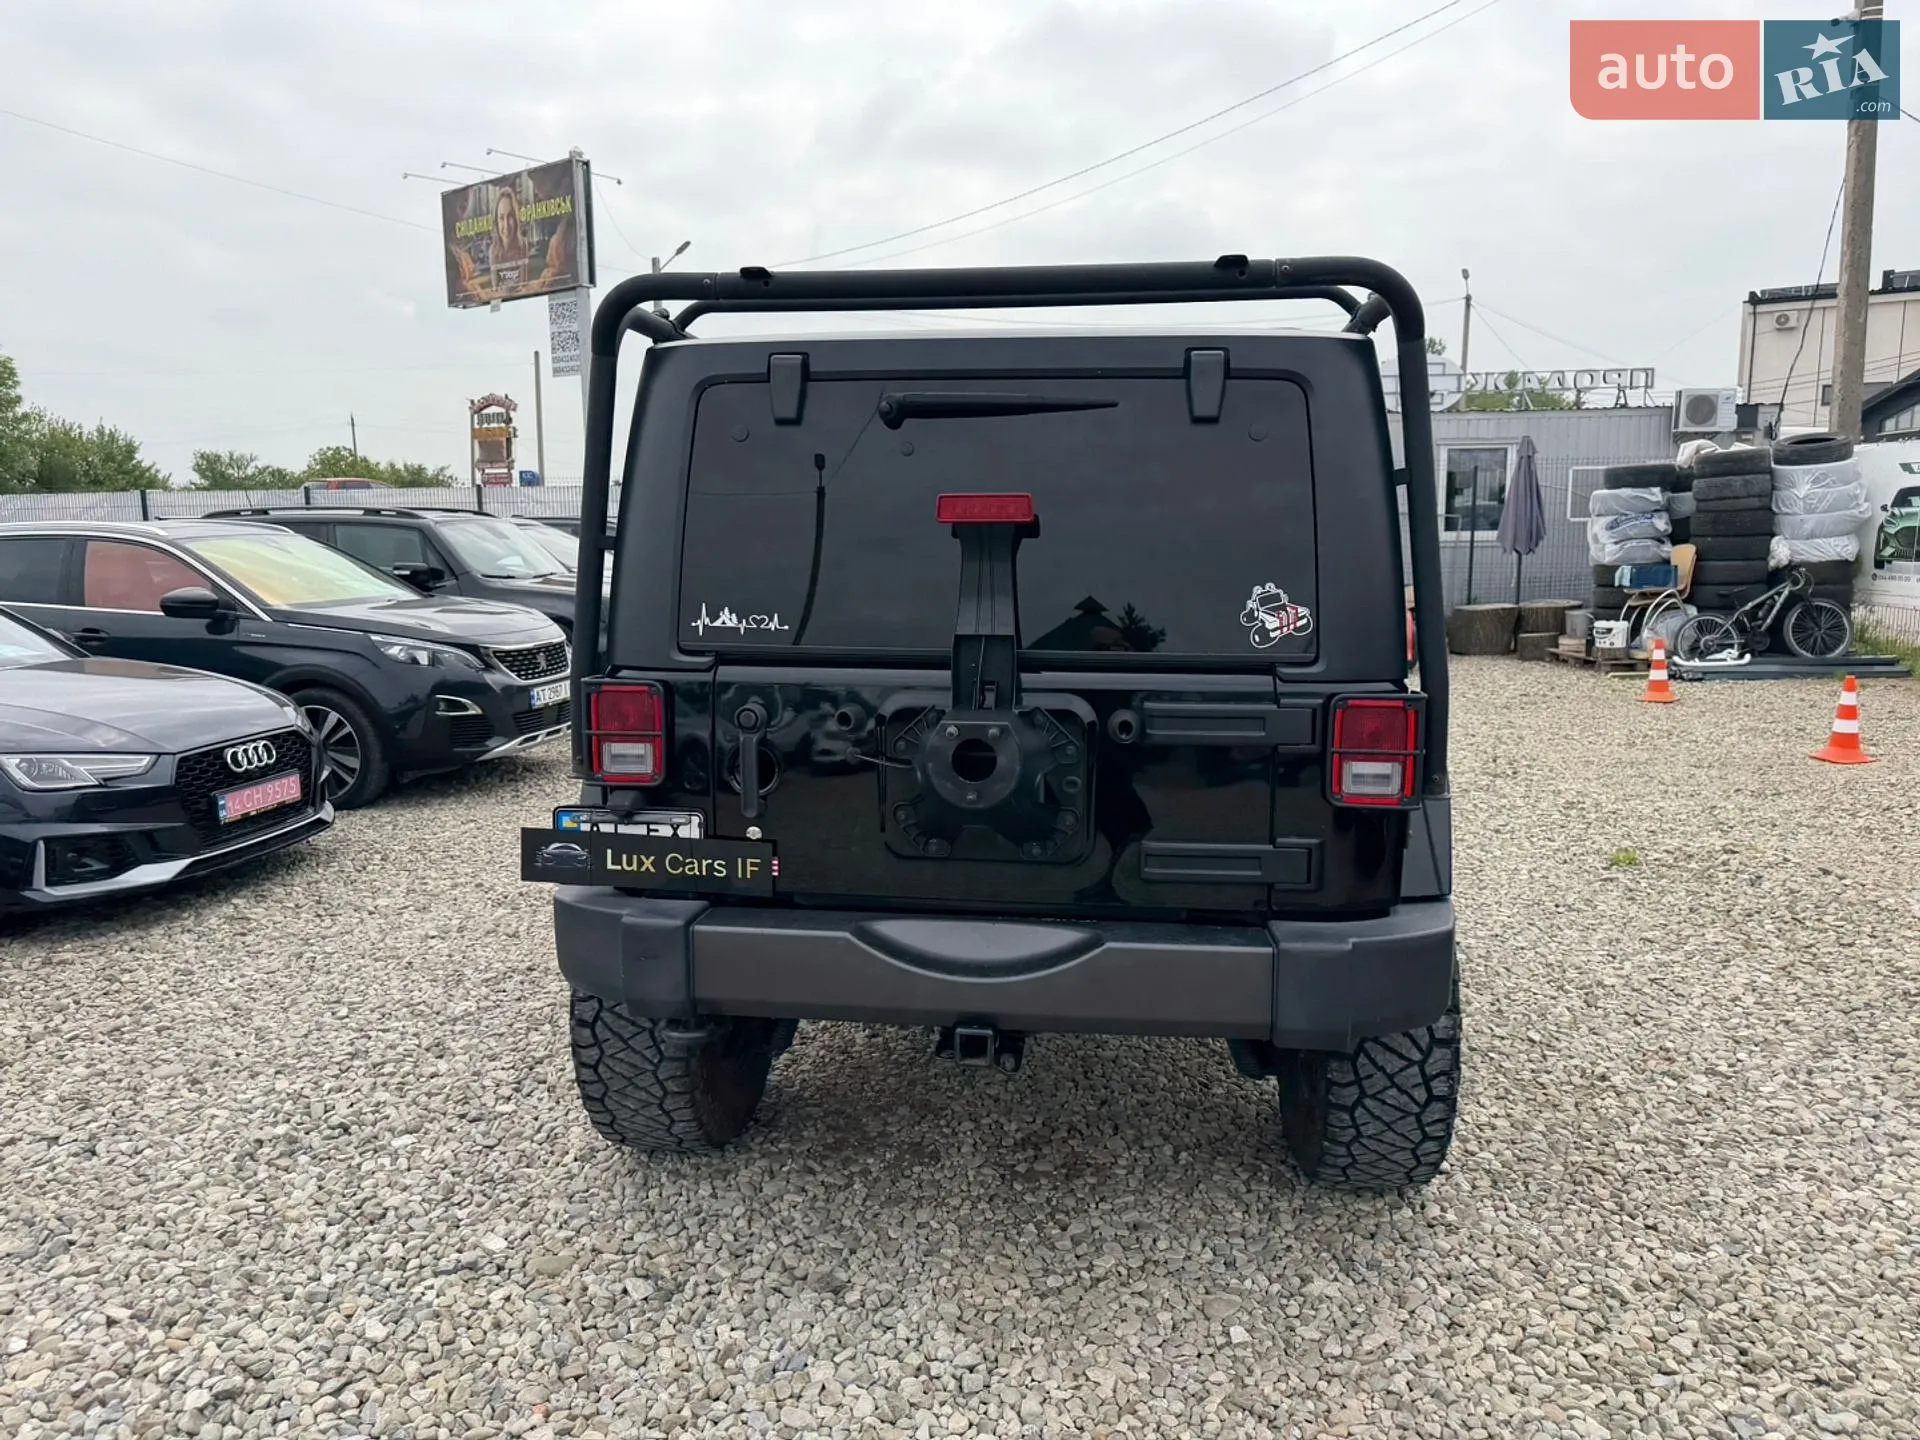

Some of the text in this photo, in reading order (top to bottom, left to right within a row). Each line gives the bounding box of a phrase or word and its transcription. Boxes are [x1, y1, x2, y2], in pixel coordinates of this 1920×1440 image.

[535, 688, 547, 703] AT
[243, 787, 263, 807] CH
[606, 848, 761, 879] Lux Cars IF
